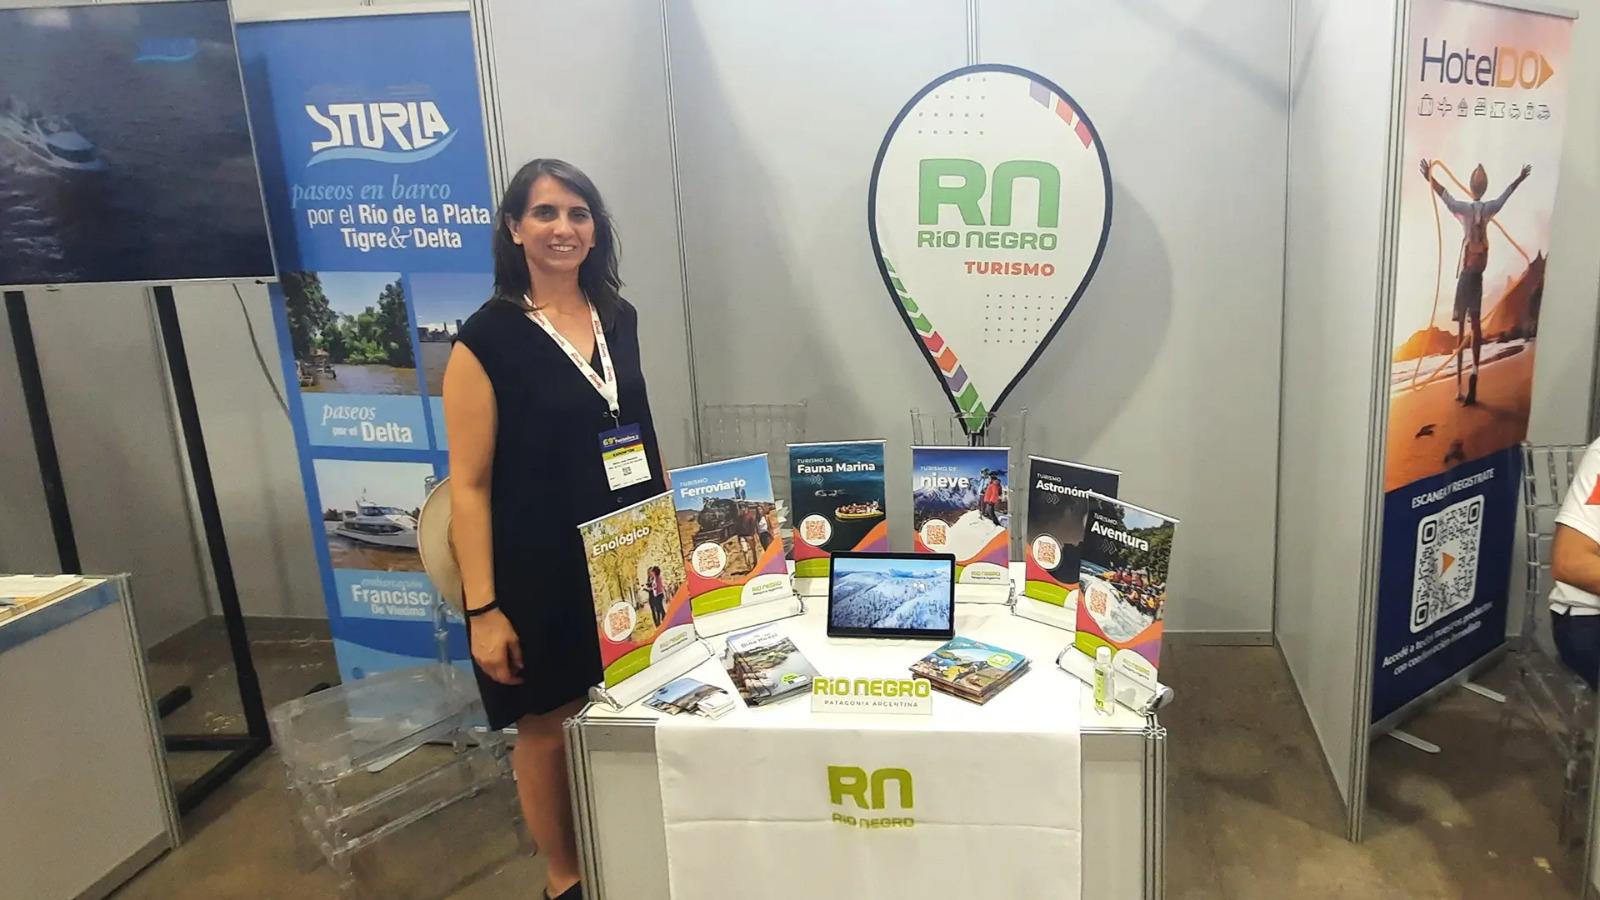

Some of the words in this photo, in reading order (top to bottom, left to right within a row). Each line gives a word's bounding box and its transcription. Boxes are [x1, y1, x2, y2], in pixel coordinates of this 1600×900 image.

[305, 101, 450, 152] STURLA
[291, 183, 354, 209] paseos
[360, 184, 385, 200] en
[391, 174, 451, 201] barco
[918, 158, 1061, 228] RN
[307, 208, 335, 229] por
[339, 205, 355, 225] el
[358, 204, 388, 225] Río
[393, 204, 416, 225] de
[420, 204, 439, 225] la
[442, 204, 491, 225] Plata
[340, 228, 388, 252] Tigre
[413, 228, 462, 249] Delta
[965, 231, 1058, 251] NEGRO
[965, 261, 1055, 277] TURISMO
[321, 404, 376, 426] paseos
[361, 421, 413, 443] Delta
[797, 463, 833, 474] Fauna
[835, 461, 876, 473] Marina
[680, 477, 747, 498] Ferroviario
[921, 472, 970, 489] nieve
[1036, 479, 1092, 500] Astronóm
[592, 526, 651, 557] Enológico
[1091, 521, 1149, 552] Aventura
[351, 584, 432, 606] Francisc
[853, 679, 930, 698] NEGRO
[827, 765, 913, 810] RN
